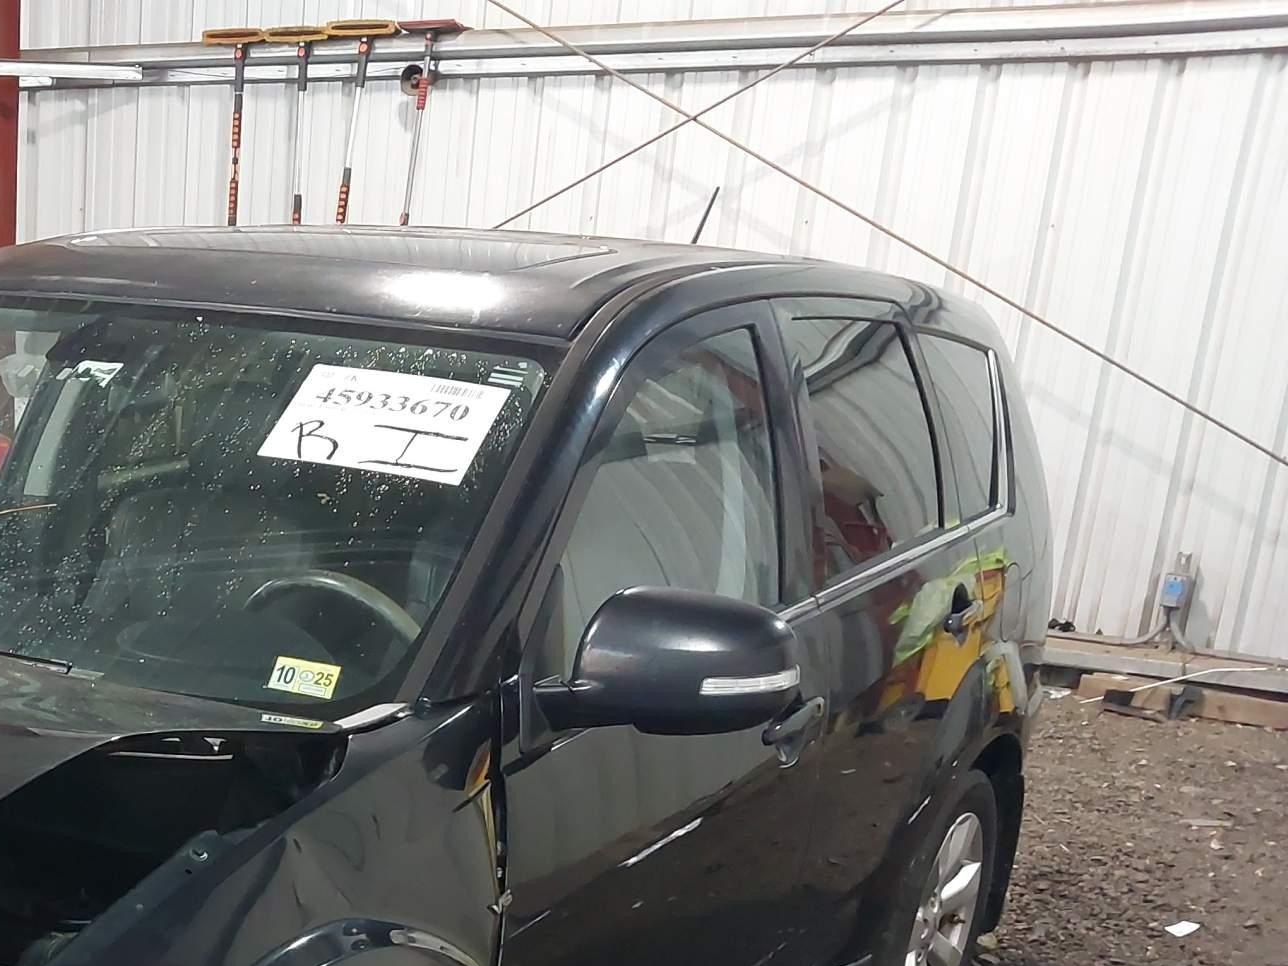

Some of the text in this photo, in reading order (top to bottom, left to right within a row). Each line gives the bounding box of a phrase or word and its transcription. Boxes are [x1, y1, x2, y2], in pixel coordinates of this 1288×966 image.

[314, 387, 471, 422] 45933670
[290, 418, 470, 473] R I
[276, 664, 335, 688] 10 25
